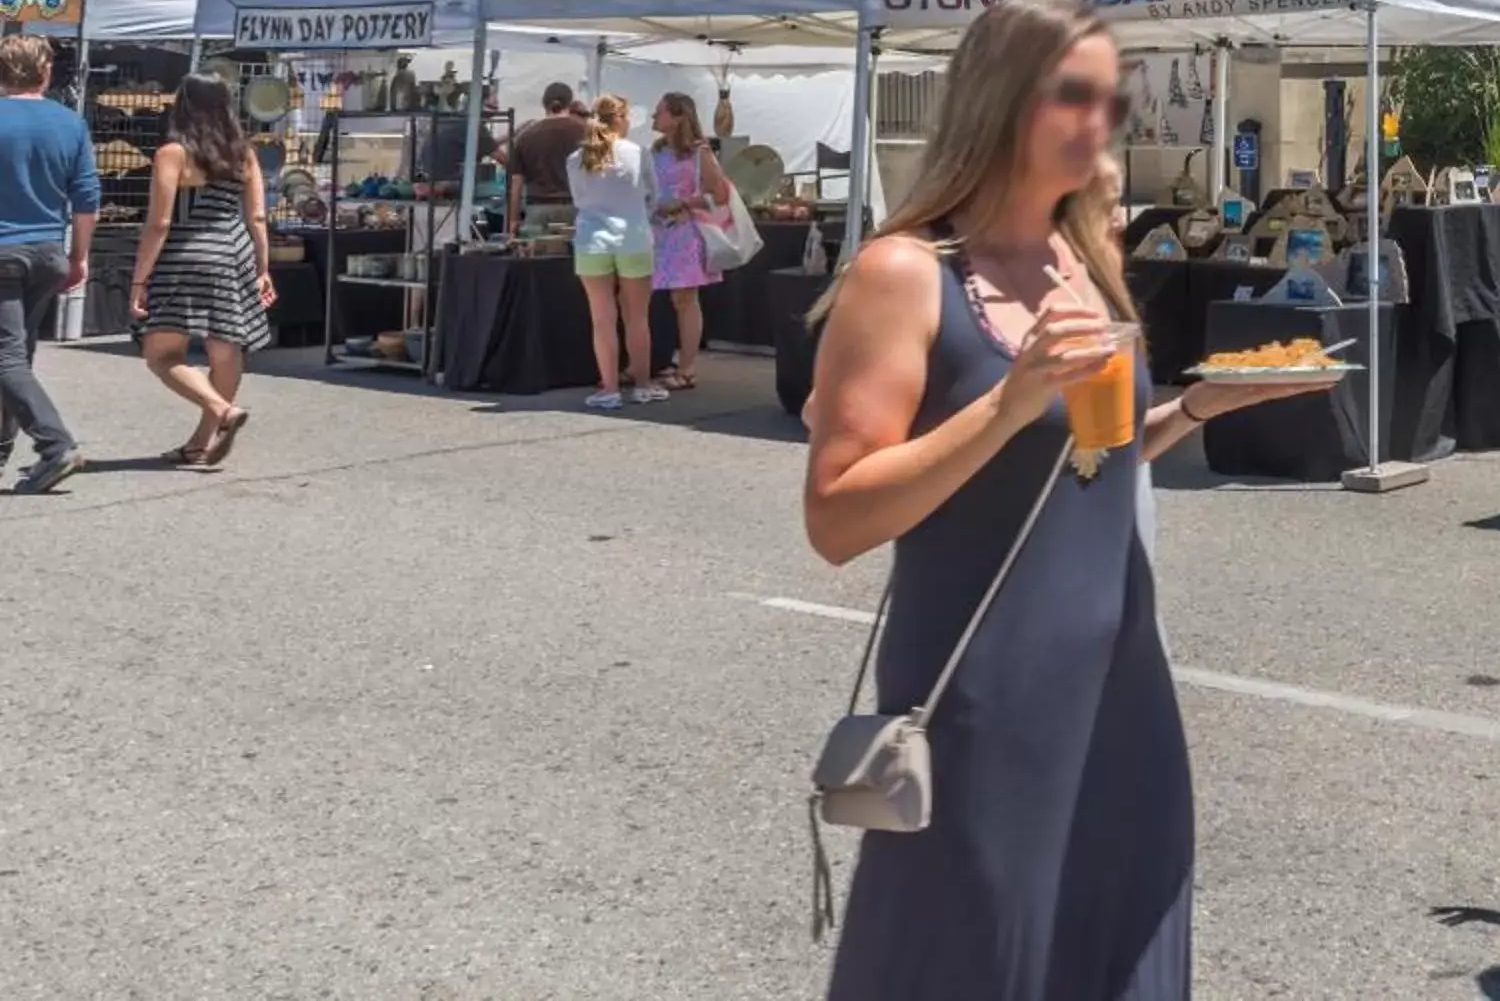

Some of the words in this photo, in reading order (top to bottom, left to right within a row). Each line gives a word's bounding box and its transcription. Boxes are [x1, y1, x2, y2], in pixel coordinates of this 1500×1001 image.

[239, 15, 293, 42] FLYNN
[298, 14, 335, 42] DAY
[342, 11, 430, 41] POTTERY
